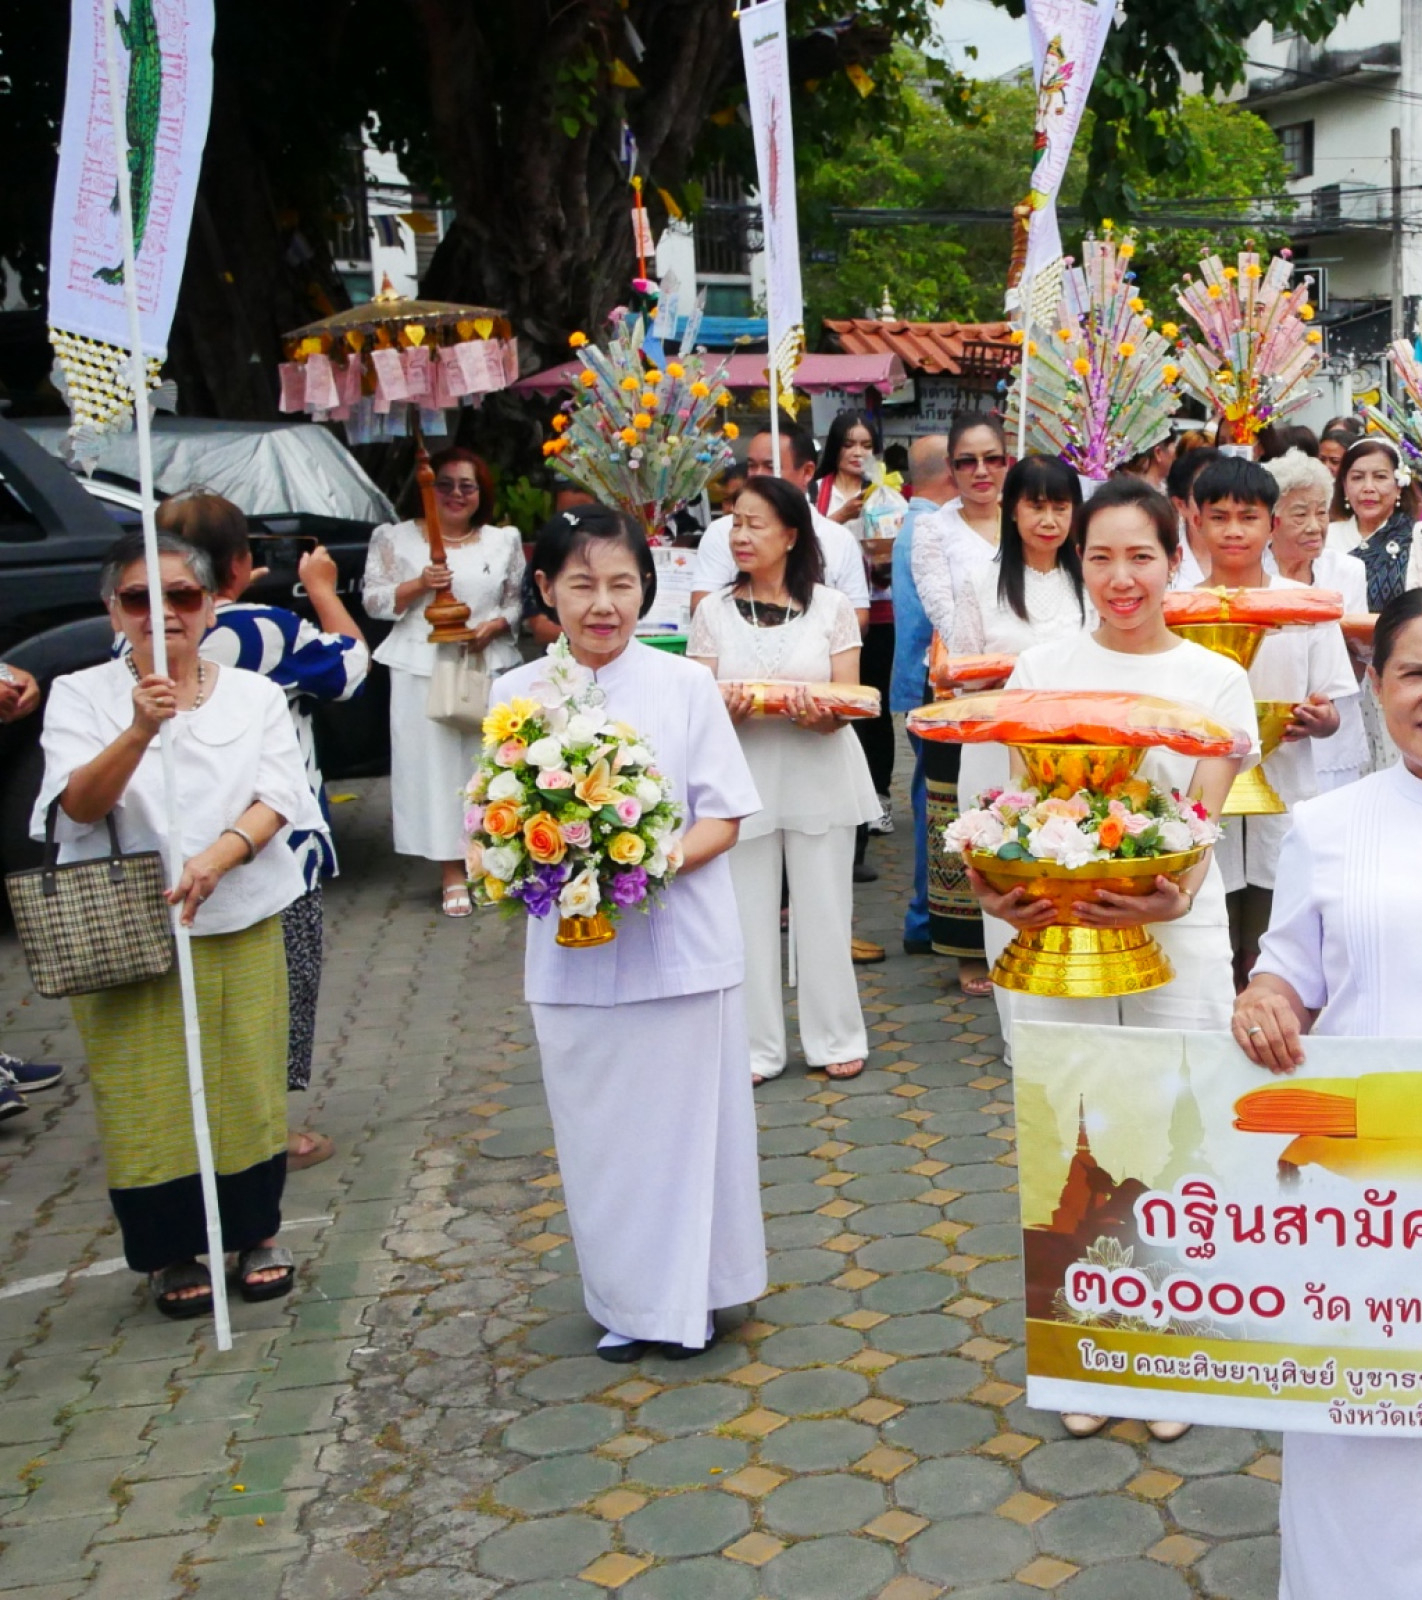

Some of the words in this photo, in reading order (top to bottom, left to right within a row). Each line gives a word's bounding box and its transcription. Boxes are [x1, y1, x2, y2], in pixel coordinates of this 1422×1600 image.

[1072, 1270, 1286, 1319] ๓๐,๐๐๐
[1303, 1281, 1351, 1321] วัด
[1080, 1342, 1125, 1369] โดย
[1136, 1353, 1335, 1392] คณะศิษยานุศิษย์
